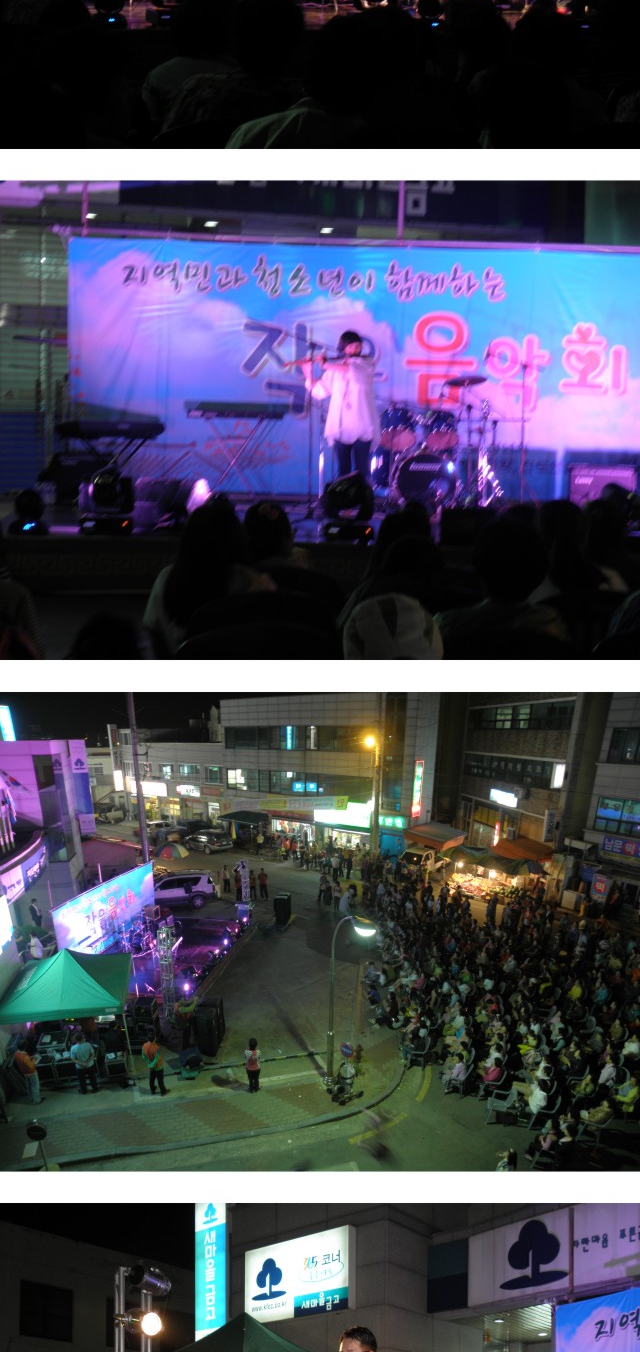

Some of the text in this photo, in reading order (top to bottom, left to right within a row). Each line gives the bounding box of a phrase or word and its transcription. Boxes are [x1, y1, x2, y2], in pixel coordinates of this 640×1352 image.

[121, 253, 508, 303] 지역민과 청소년이 함께하는
[403, 311, 629, 413] 음악회
[619, 1223, 640, 1242] 푸른
[321, 1249, 341, 1266] 코너
[203, 1229, 216, 1322] 새마을금고
[301, 1292, 340, 1311] 새마을금고
